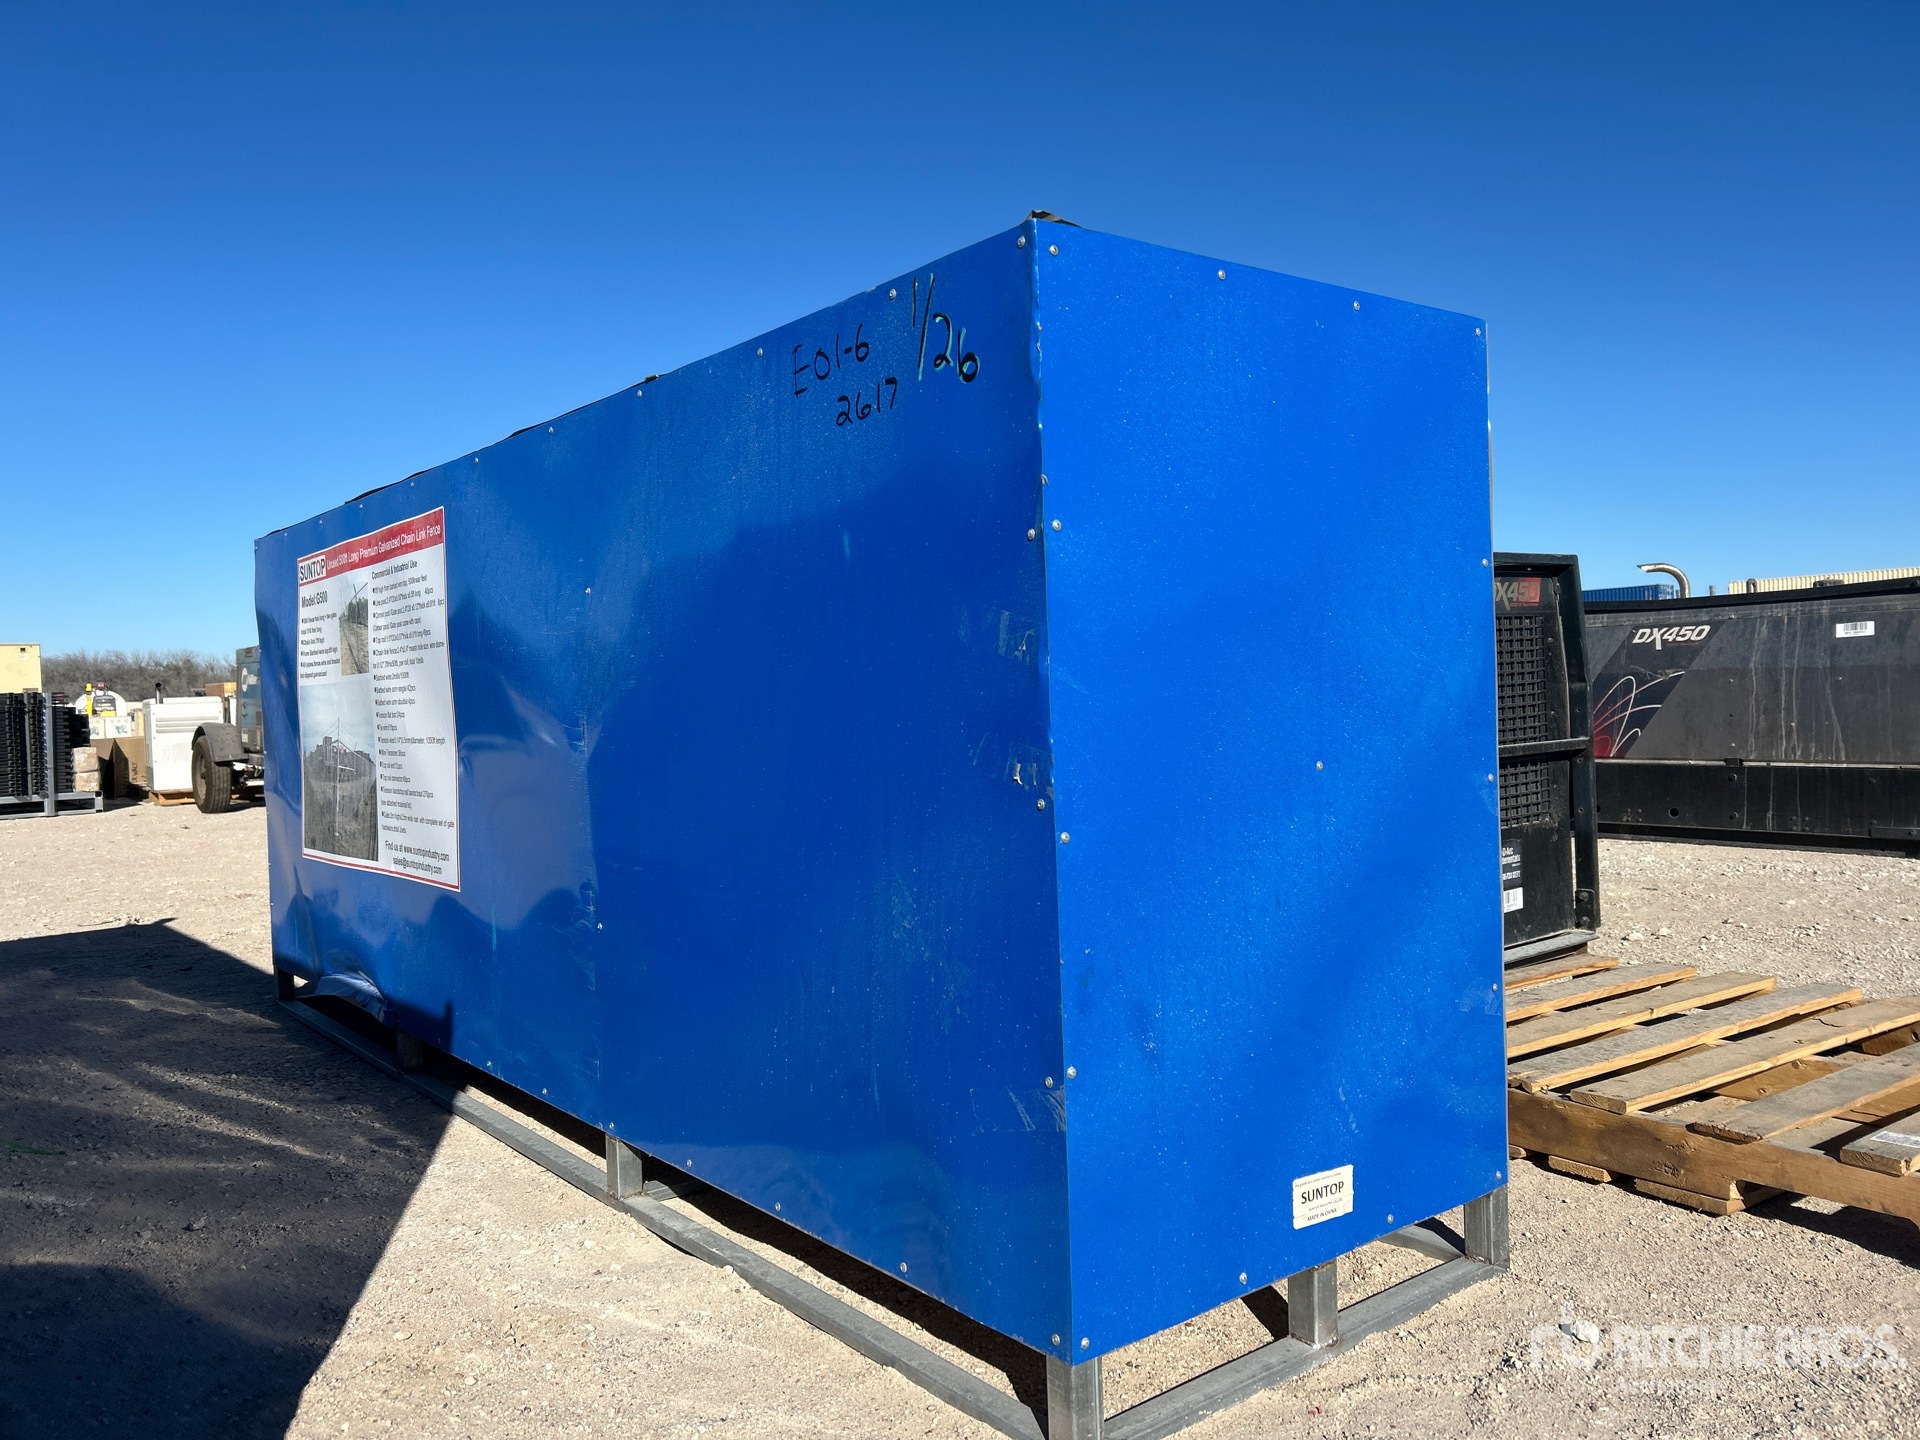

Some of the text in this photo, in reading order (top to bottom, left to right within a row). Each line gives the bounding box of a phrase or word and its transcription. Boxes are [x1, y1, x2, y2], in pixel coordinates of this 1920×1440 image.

[911, 273, 980, 384] 1/26
[835, 376, 898, 426] 2617
[348, 550, 359, 564] Long
[360, 543, 378, 559] Premium
[378, 535, 400, 554] Galvanized
[400, 530, 415, 545] Chain
[415, 526, 426, 542] Link
[426, 523, 441, 539] Fence
[300, 560, 326, 582] SUNTOP
[371, 566, 390, 580] Commercial
[393, 560, 409, 573] Industrial
[409, 559, 418, 569] Use
[1494, 581, 1540, 611] X450
[1632, 624, 1711, 651] DX450
[385, 839, 393, 851] Find
[394, 842, 398, 851] us
[403, 845, 450, 862] www.suntopindustry.com
[392, 856, 442, 875] sales@suntopindustry.com
[1301, 1181, 1345, 1205] SUNTOP
[1307, 1213, 1319, 1221] MADE
[1325, 1208, 1337, 1216] CHINA
